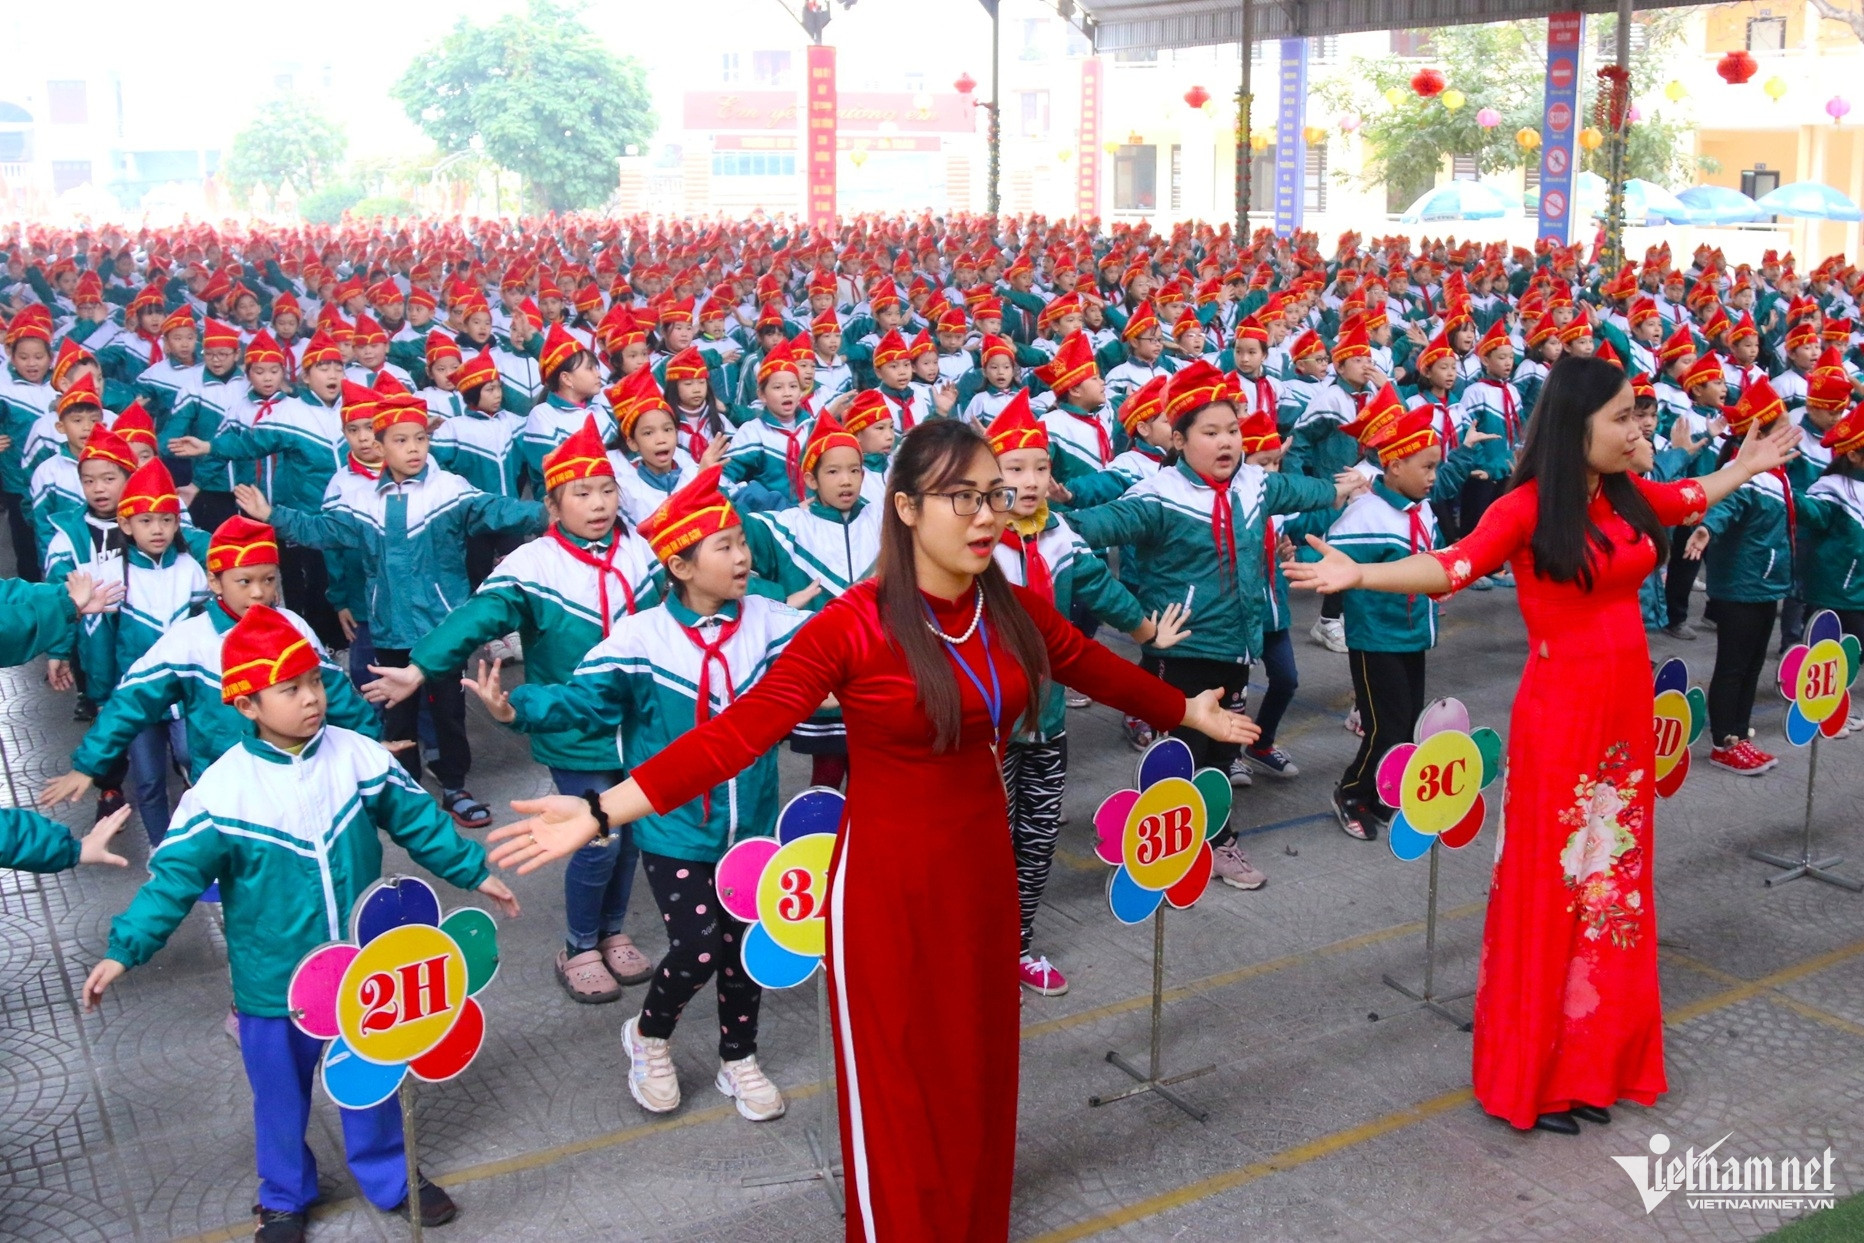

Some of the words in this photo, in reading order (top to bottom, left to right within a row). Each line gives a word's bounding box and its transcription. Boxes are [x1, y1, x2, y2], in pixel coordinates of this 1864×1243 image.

[1549, 111, 1570, 124] STOP
[1804, 658, 1838, 700] 3E
[1416, 757, 1466, 802] 3C
[1136, 806, 1193, 865] 3B
[778, 868, 827, 922] 3
[360, 954, 452, 1036] 2H
